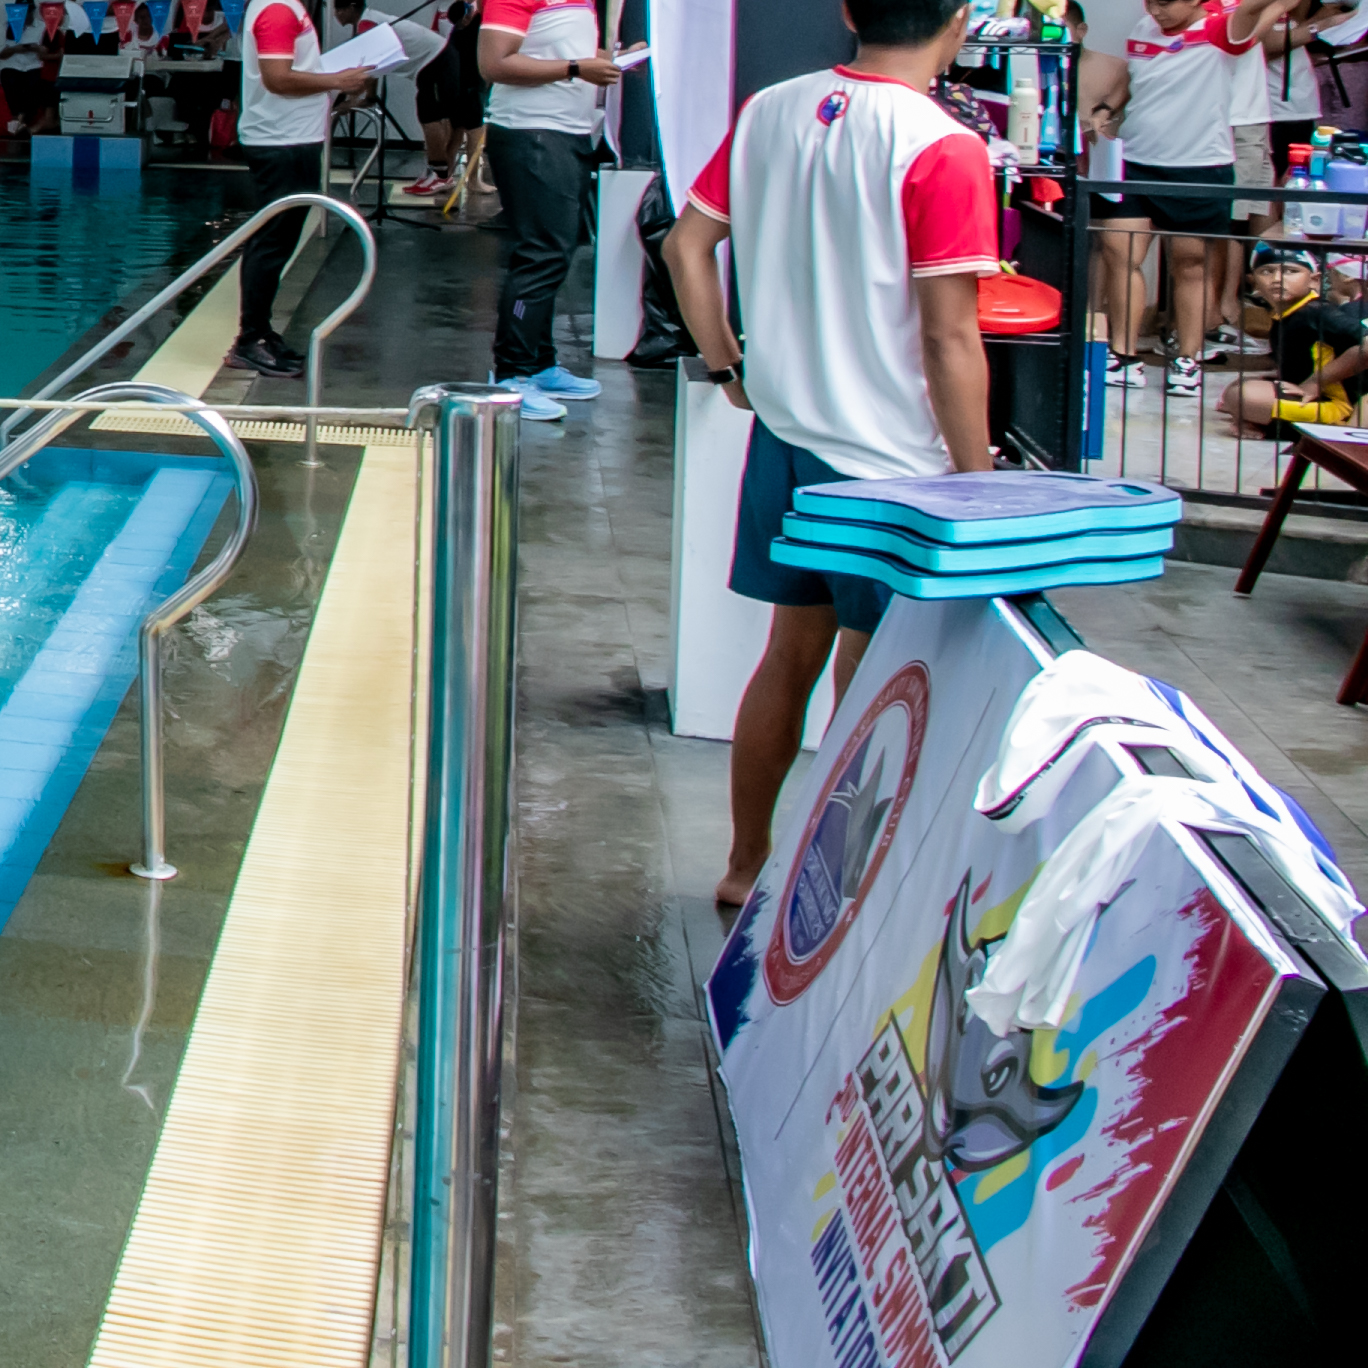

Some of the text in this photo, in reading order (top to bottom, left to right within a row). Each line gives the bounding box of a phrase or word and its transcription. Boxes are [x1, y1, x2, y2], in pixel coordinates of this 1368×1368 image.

[810, 1208, 881, 1368] INVITATIO
[825, 1070, 942, 1368] 2ND INTERNAL SWIMM
[859, 1021, 998, 1360] PARI SAKTI
